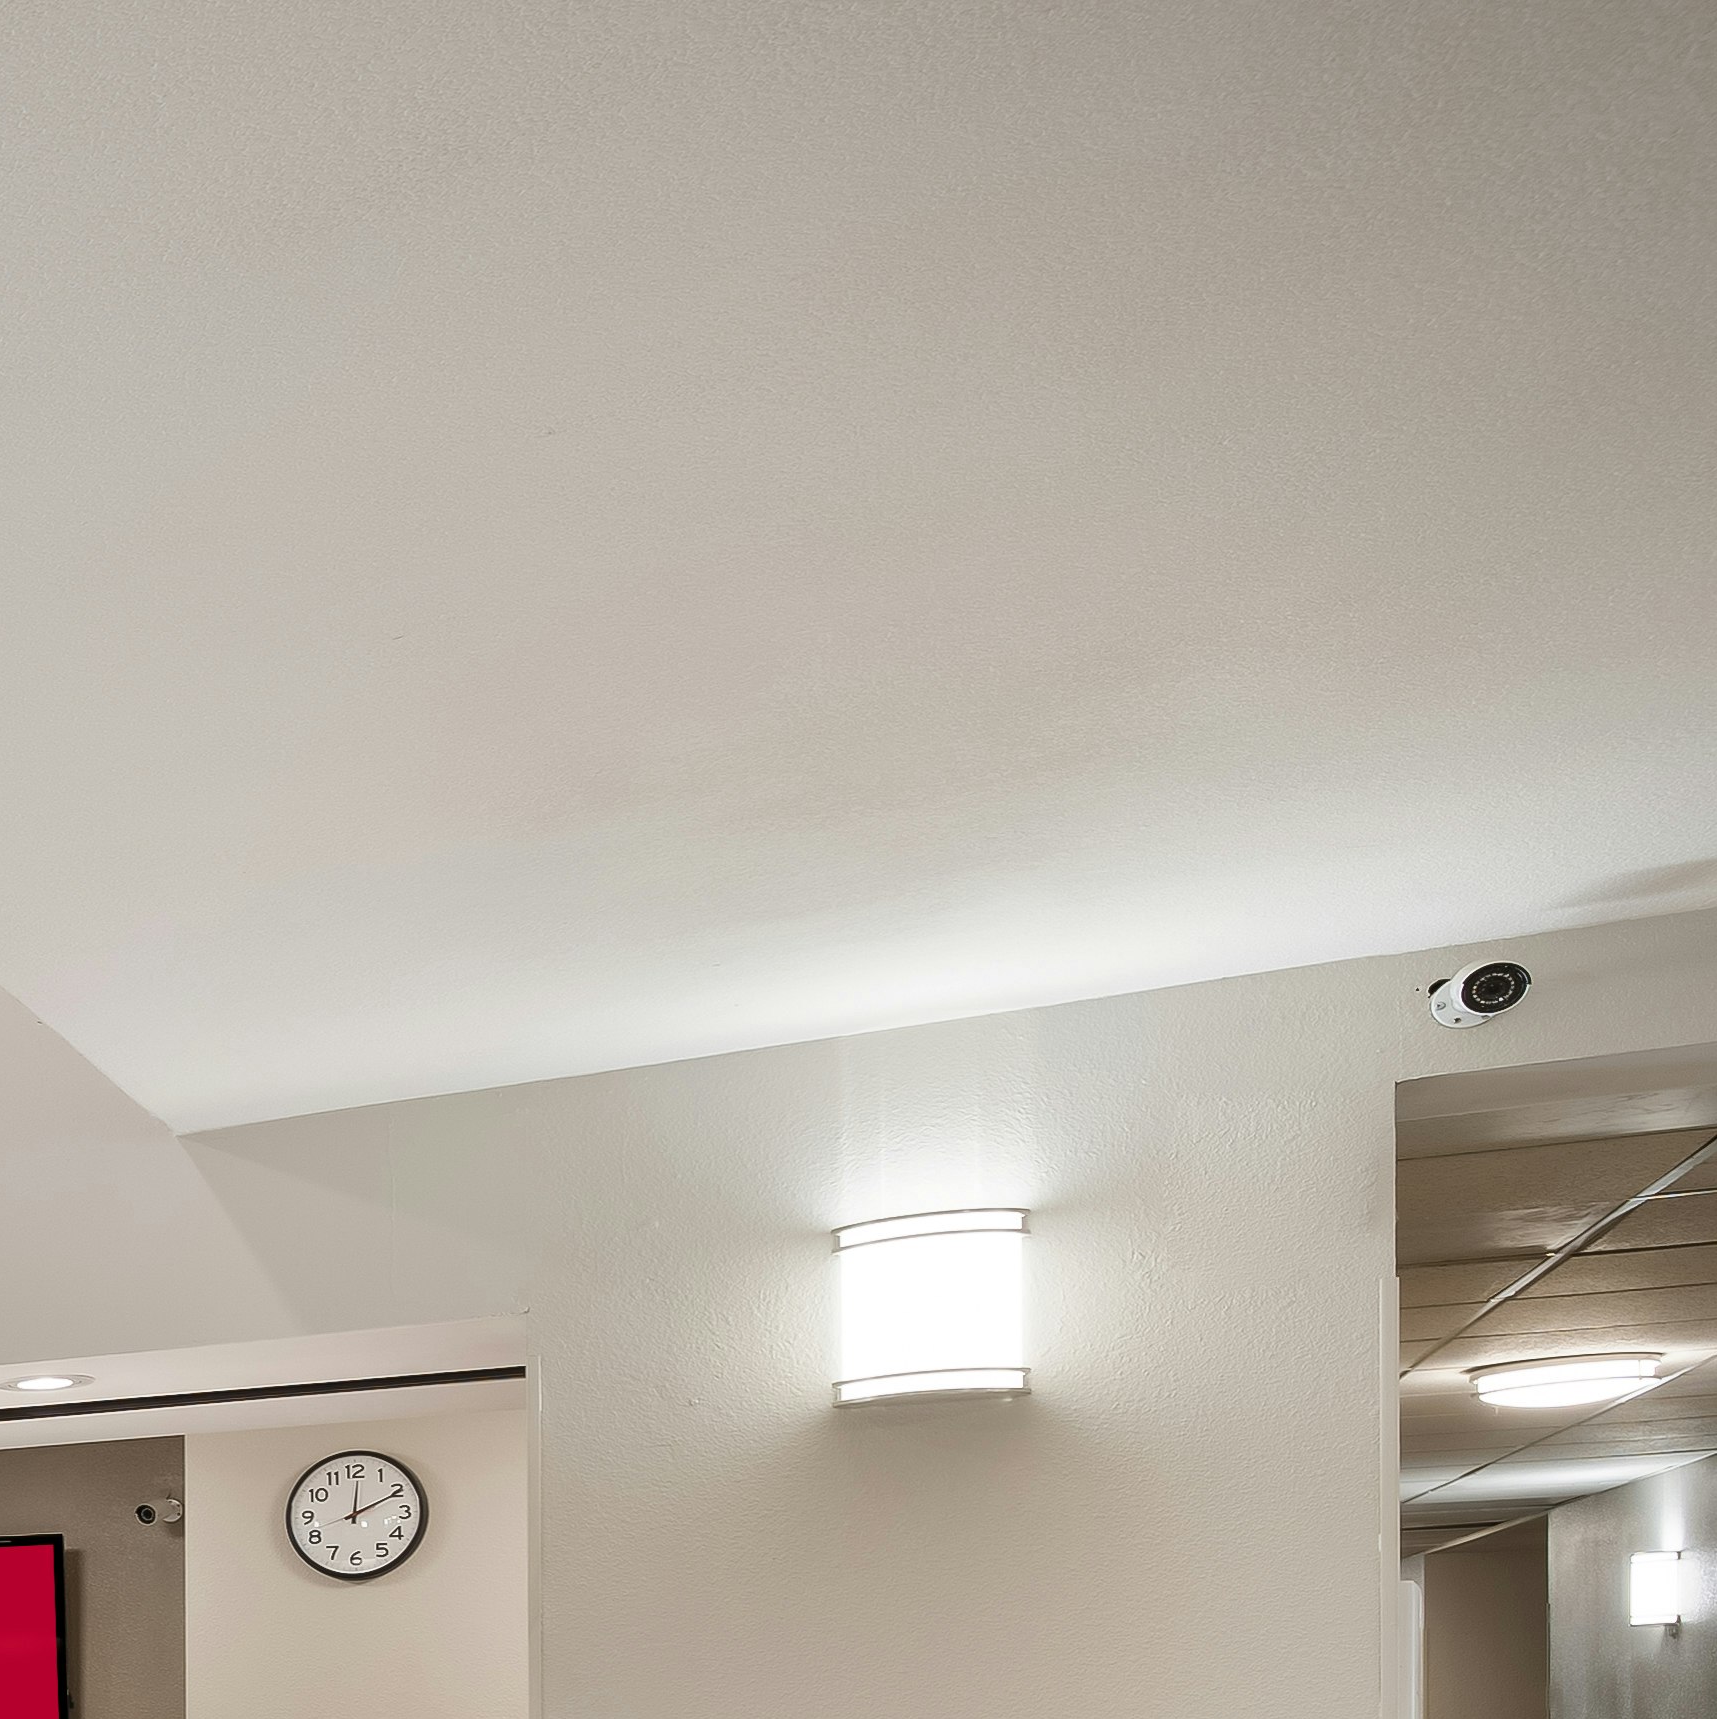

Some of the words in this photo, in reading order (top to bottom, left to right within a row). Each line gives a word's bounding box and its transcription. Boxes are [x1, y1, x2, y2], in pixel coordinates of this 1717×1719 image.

[326, 1471, 339, 1485] 11
[345, 1464, 365, 1479] 12
[377, 1468, 383, 1482] 1
[309, 1487, 328, 1502] 10
[391, 1483, 404, 1497] 2
[301, 1510, 314, 1525] 9
[398, 1504, 411, 1519] 3
[308, 1530, 322, 1544] 8
[388, 1526, 404, 1540] 4
[326, 1545, 339, 1560] 7
[376, 1542, 389, 1557] 5
[349, 1551, 362, 1566] 6
